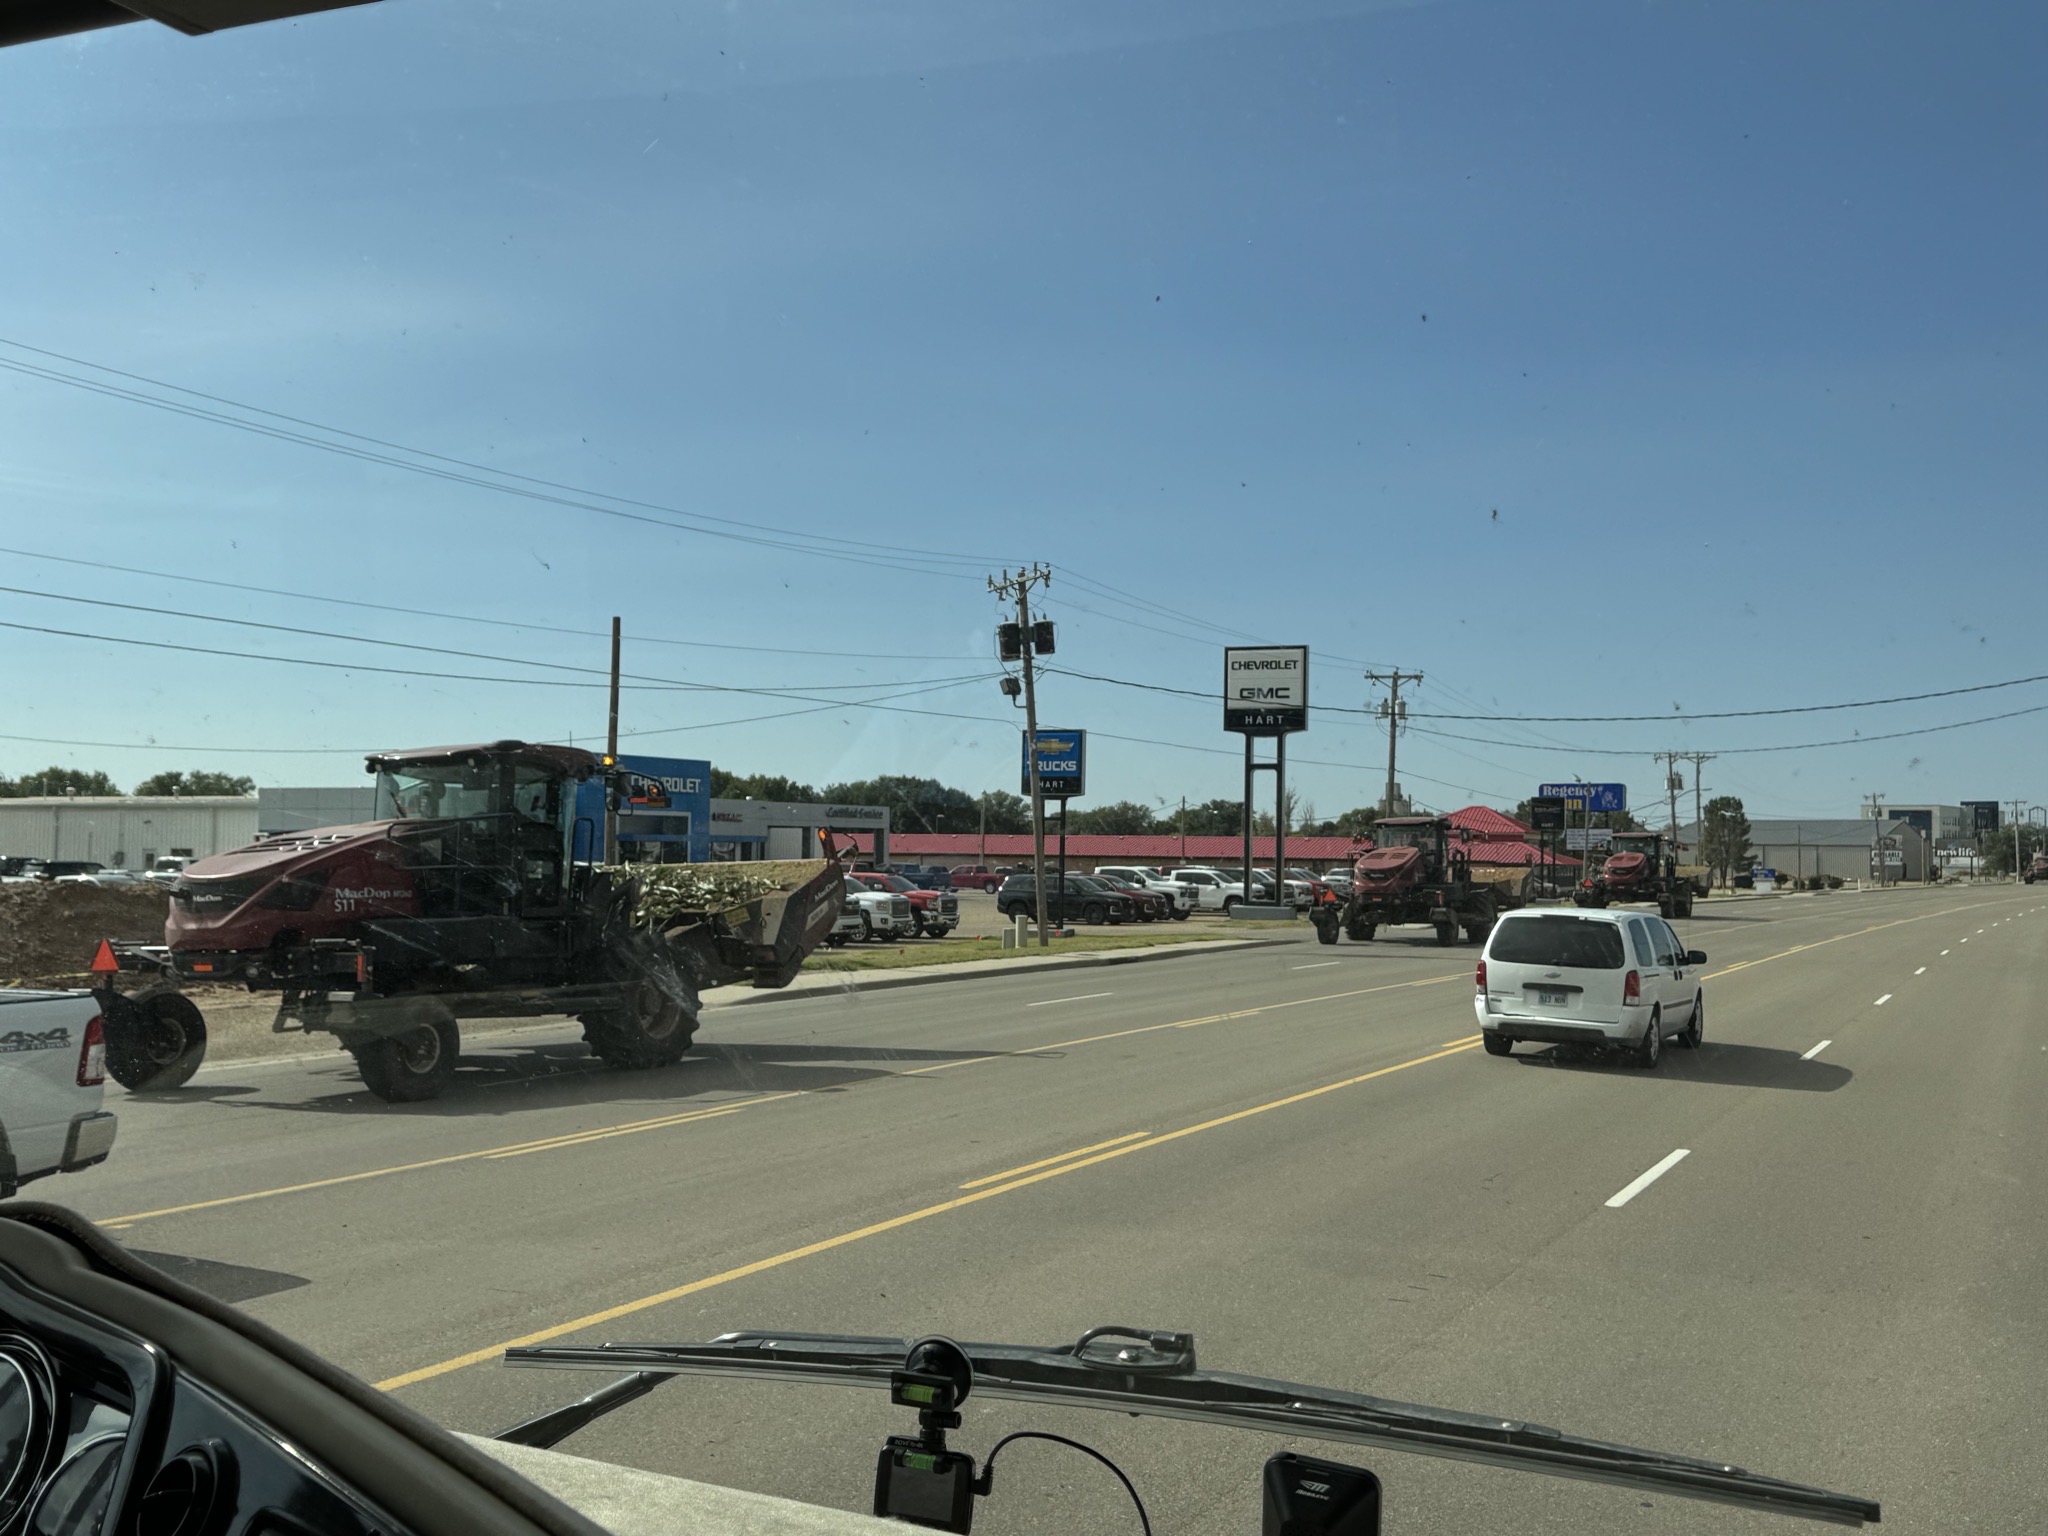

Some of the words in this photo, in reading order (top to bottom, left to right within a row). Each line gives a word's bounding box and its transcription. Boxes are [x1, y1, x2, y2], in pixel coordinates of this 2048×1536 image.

[1231, 660, 1298, 670] CHEVROLET
[1240, 687, 1290, 699] GMC
[1245, 715, 1283, 725] HART
[1027, 760, 1077, 771] RUCKS
[335, 887, 391, 899] MacDon
